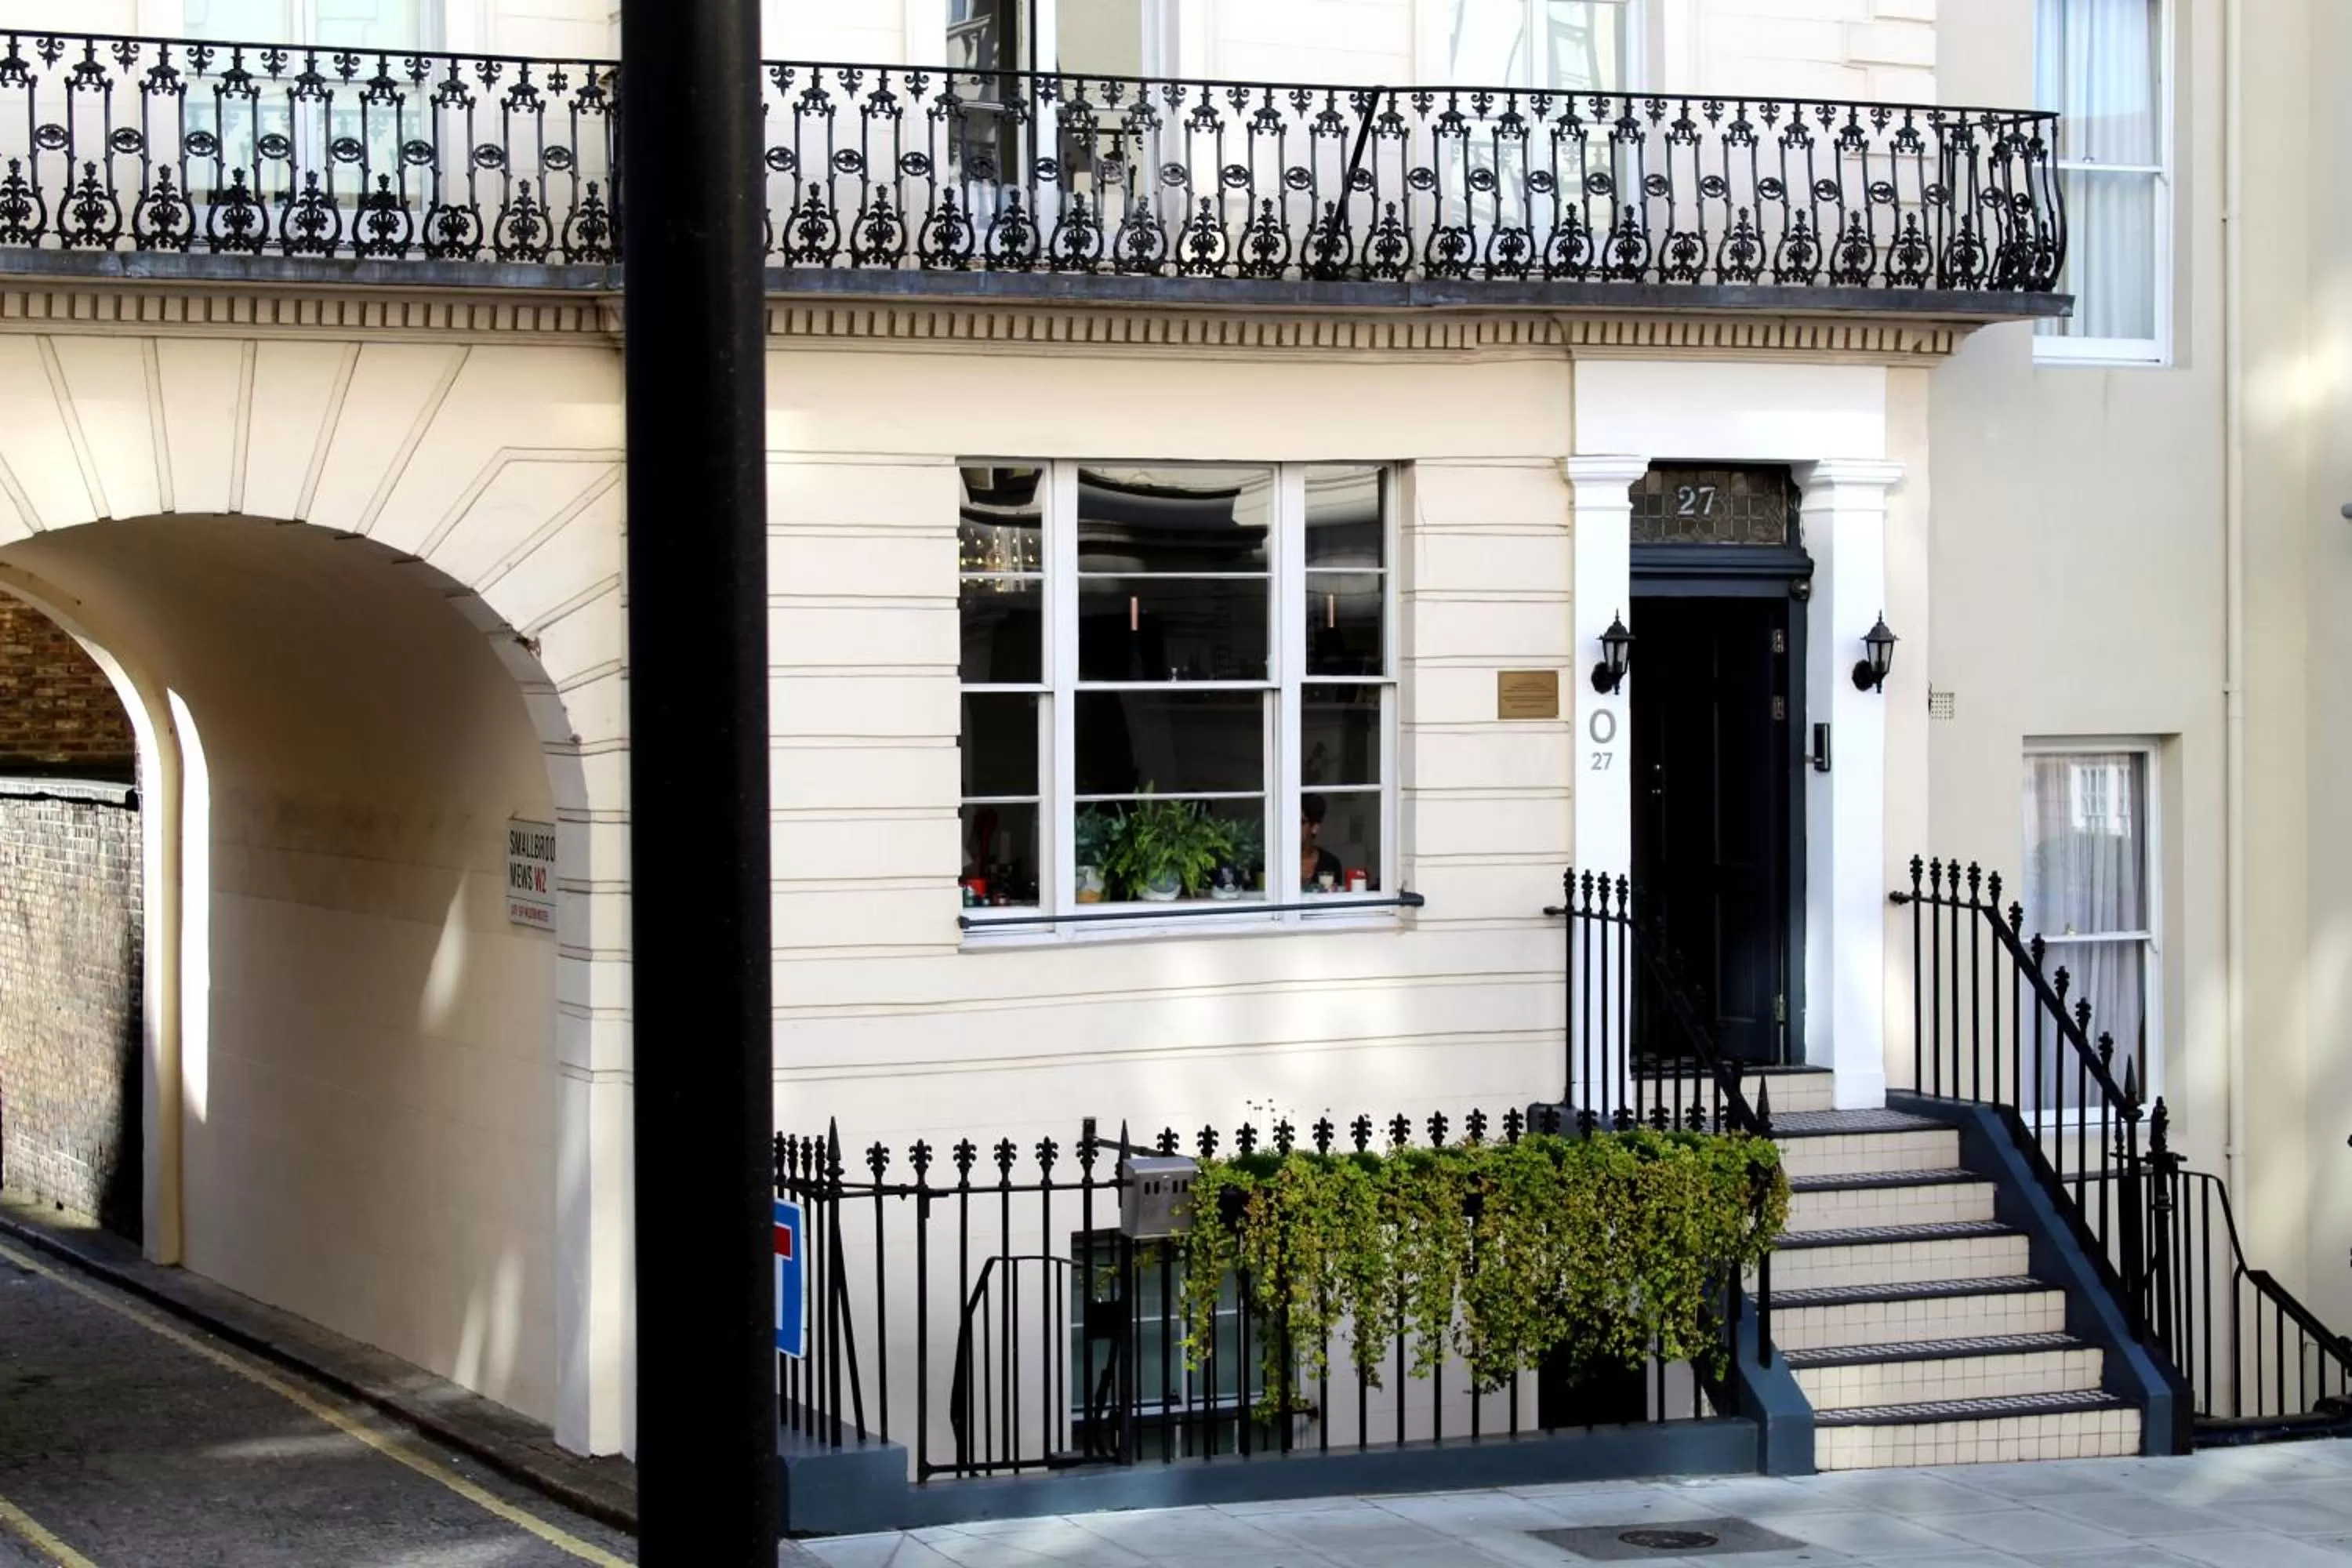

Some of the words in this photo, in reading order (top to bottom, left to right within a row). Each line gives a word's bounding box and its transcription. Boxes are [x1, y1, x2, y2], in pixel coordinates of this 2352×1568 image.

[1677, 485, 1716, 515] 27
[1591, 752, 1613, 771] 27
[510, 829, 556, 862] SMALLBROO
[510, 862, 533, 891] MEWS
[534, 866, 547, 894] W2
